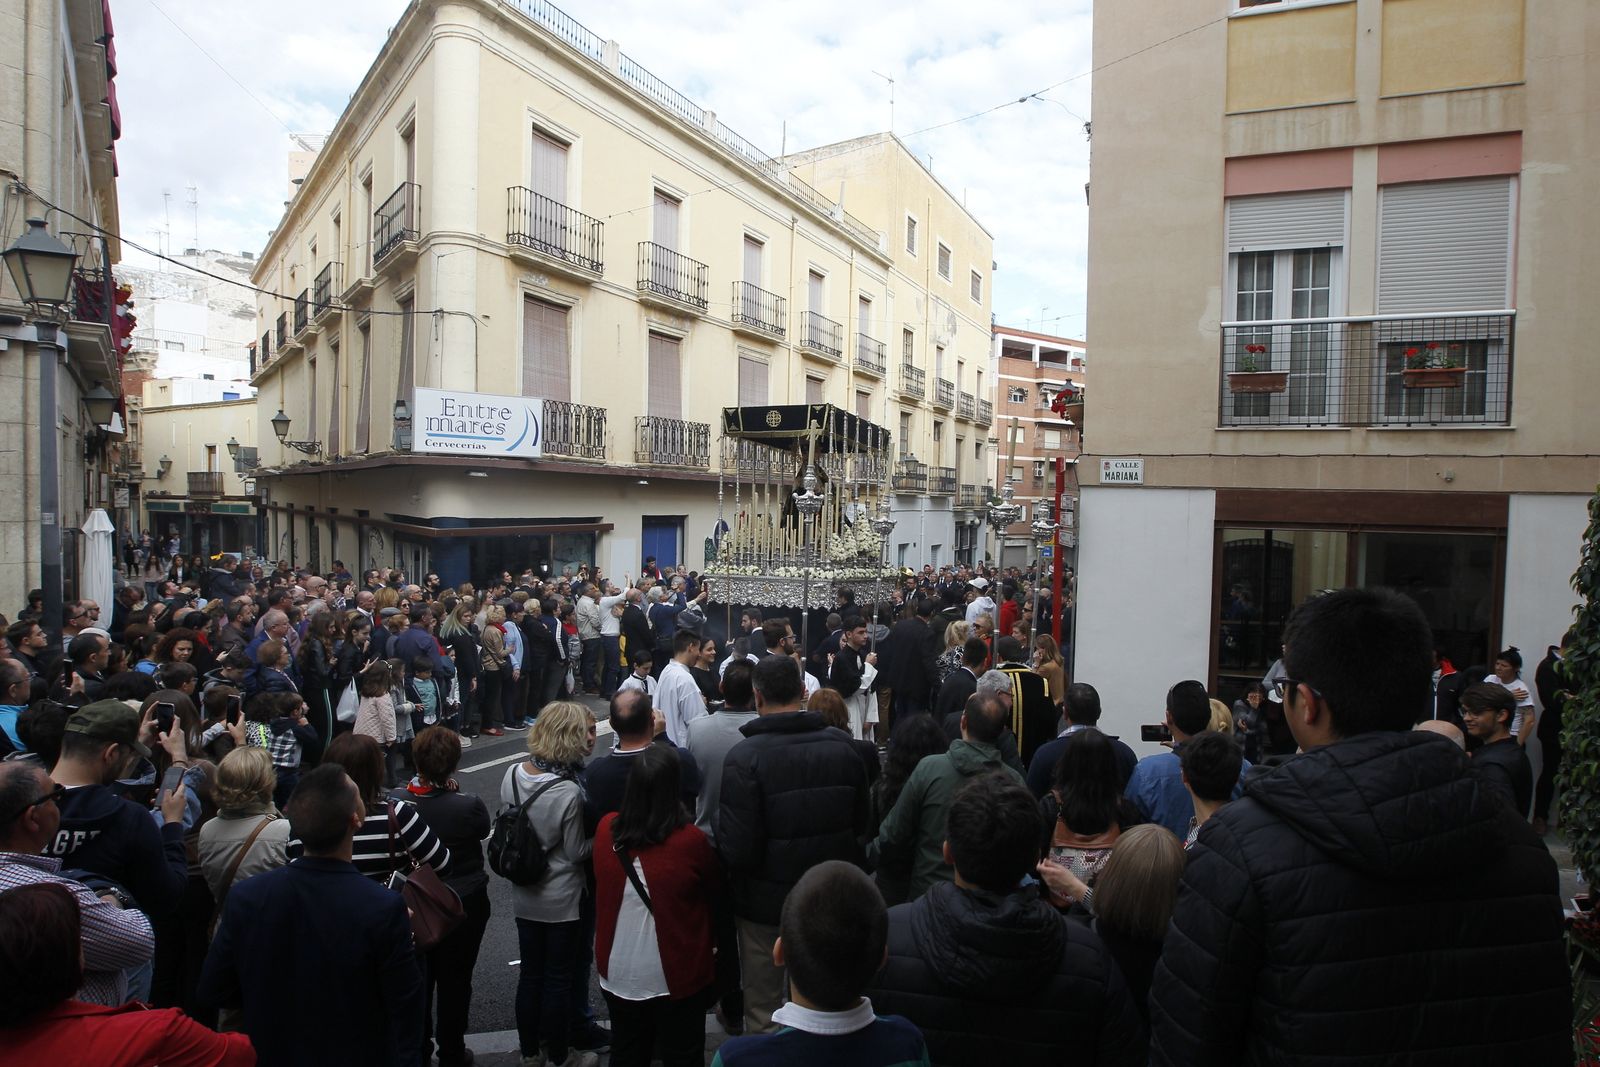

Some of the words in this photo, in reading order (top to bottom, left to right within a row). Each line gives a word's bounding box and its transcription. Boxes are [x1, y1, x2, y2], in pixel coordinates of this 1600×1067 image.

[440, 398, 512, 420] Entre
[425, 417, 506, 435] mares
[1104, 471, 1139, 481] MARIANA
